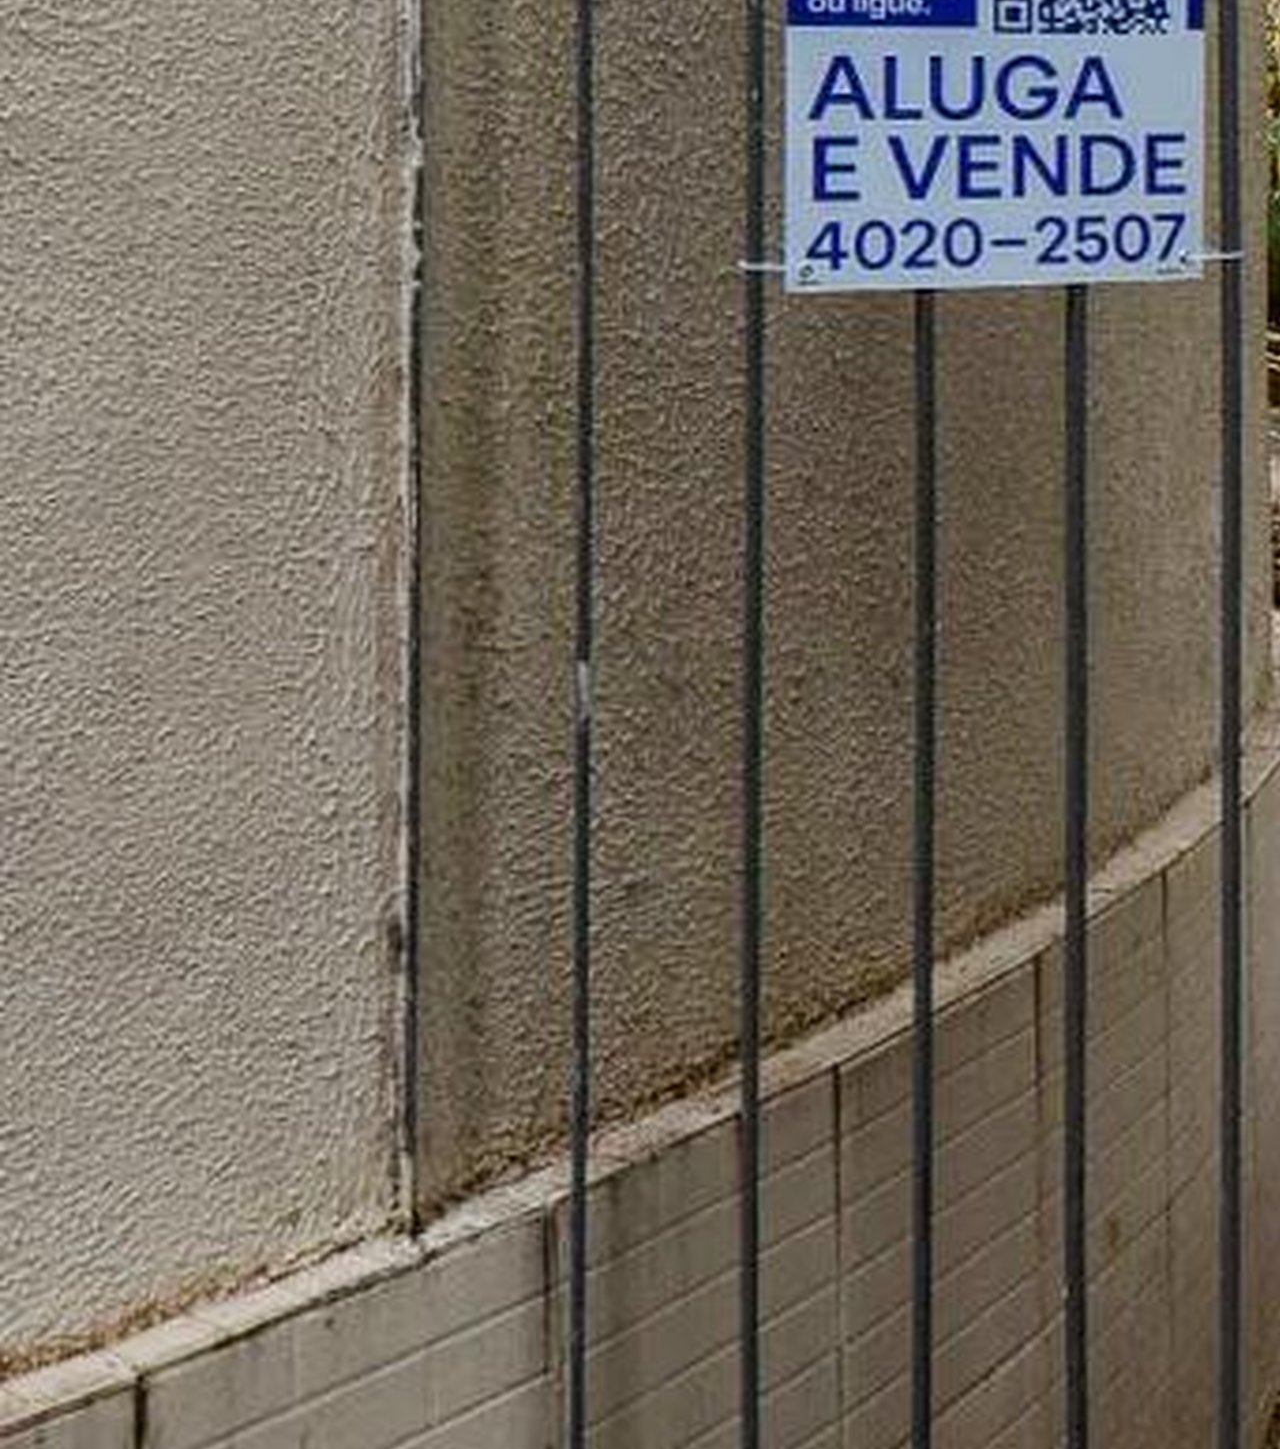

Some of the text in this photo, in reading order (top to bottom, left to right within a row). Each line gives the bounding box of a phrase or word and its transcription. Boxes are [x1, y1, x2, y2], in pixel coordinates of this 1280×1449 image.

[808, 55, 1123, 121] ALUGA
[813, 134, 1186, 201] E VENDE
[807, 214, 1187, 271] 4020-2507
